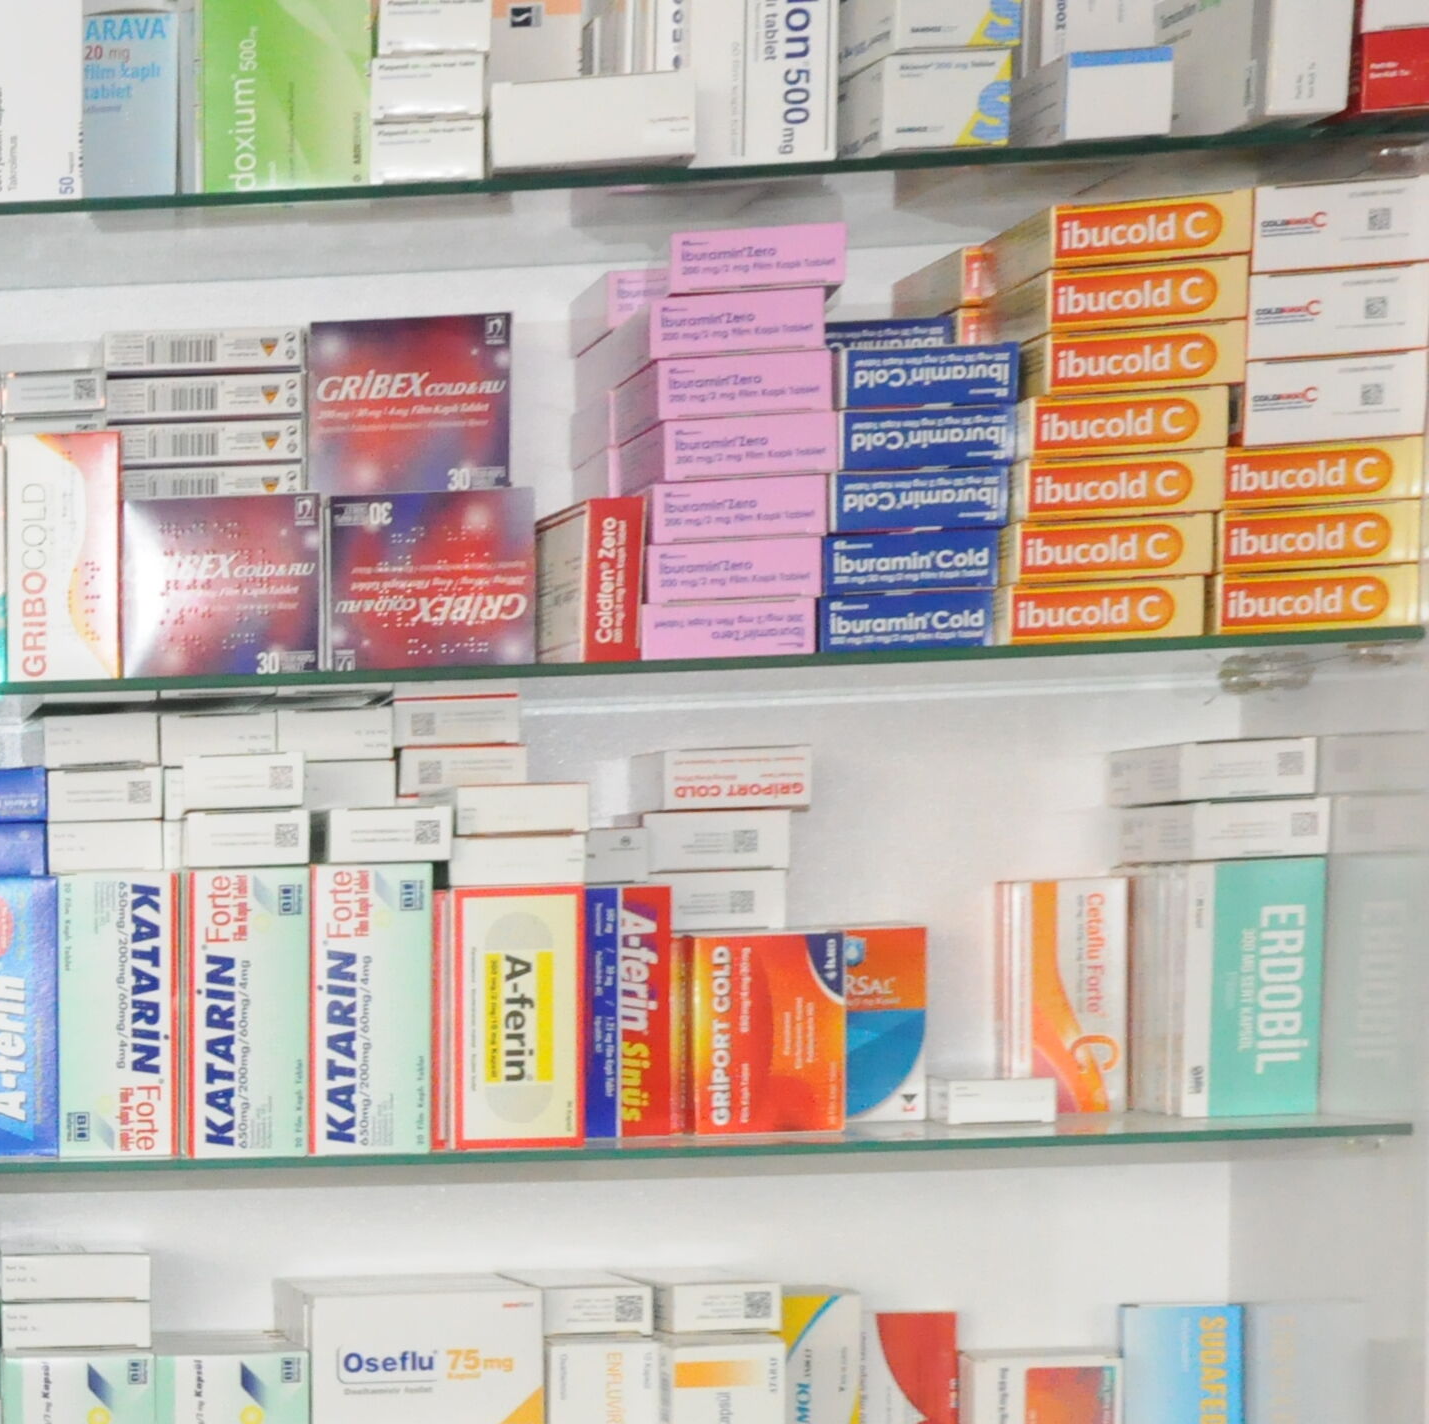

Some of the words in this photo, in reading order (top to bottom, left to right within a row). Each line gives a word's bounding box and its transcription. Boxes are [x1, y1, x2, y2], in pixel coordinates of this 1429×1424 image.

[86, 18, 166, 40] ARAVA
[84, 45, 104, 61] 20
[782, 67, 811, 125] 500
[228, 77, 257, 192] doxium
[1061, 213, 1177, 251] ibucold
[1183, 210, 1208, 240] C
[1057, 344, 1172, 379] ibucold
[1179, 342, 1205, 370] C
[316, 369, 430, 401] GRİBEX
[851, 432, 904, 452] Cold
[1041, 408, 1153, 443] ibucold
[1161, 405, 1186, 434] C
[447, 468, 470, 491] 30
[1230, 459, 1342, 494] ibucold
[1353, 455, 1379, 486] C
[595, 516, 617, 555] Zero
[1026, 532, 1139, 567] ibucold
[1146, 531, 1170, 560] C
[936, 548, 990, 569] Cold
[416, 592, 527, 623] GRİBEX
[595, 562, 613, 643] Coldfen
[932, 609, 985, 630] Cold
[1227, 584, 1342, 621] ibucold
[1352, 583, 1377, 613] C
[674, 785, 721, 798] COLD
[204, 875, 232, 944] Forte
[1086, 892, 1106, 961] Cetaflu
[130, 883, 170, 1074] KATARİN
[711, 945, 731, 1013] COLD
[1255, 904, 1309, 1075] ERDOBİL
[503, 954, 535, 1083] A-ferin
[195, 954, 237, 1146] KATARİN
[620, 1039, 650, 1122] Sinüs
[709, 1020, 731, 1125] GRİPORT
[136, 1084, 162, 1152] Forte
[343, 1350, 435, 1373] Oseflu
